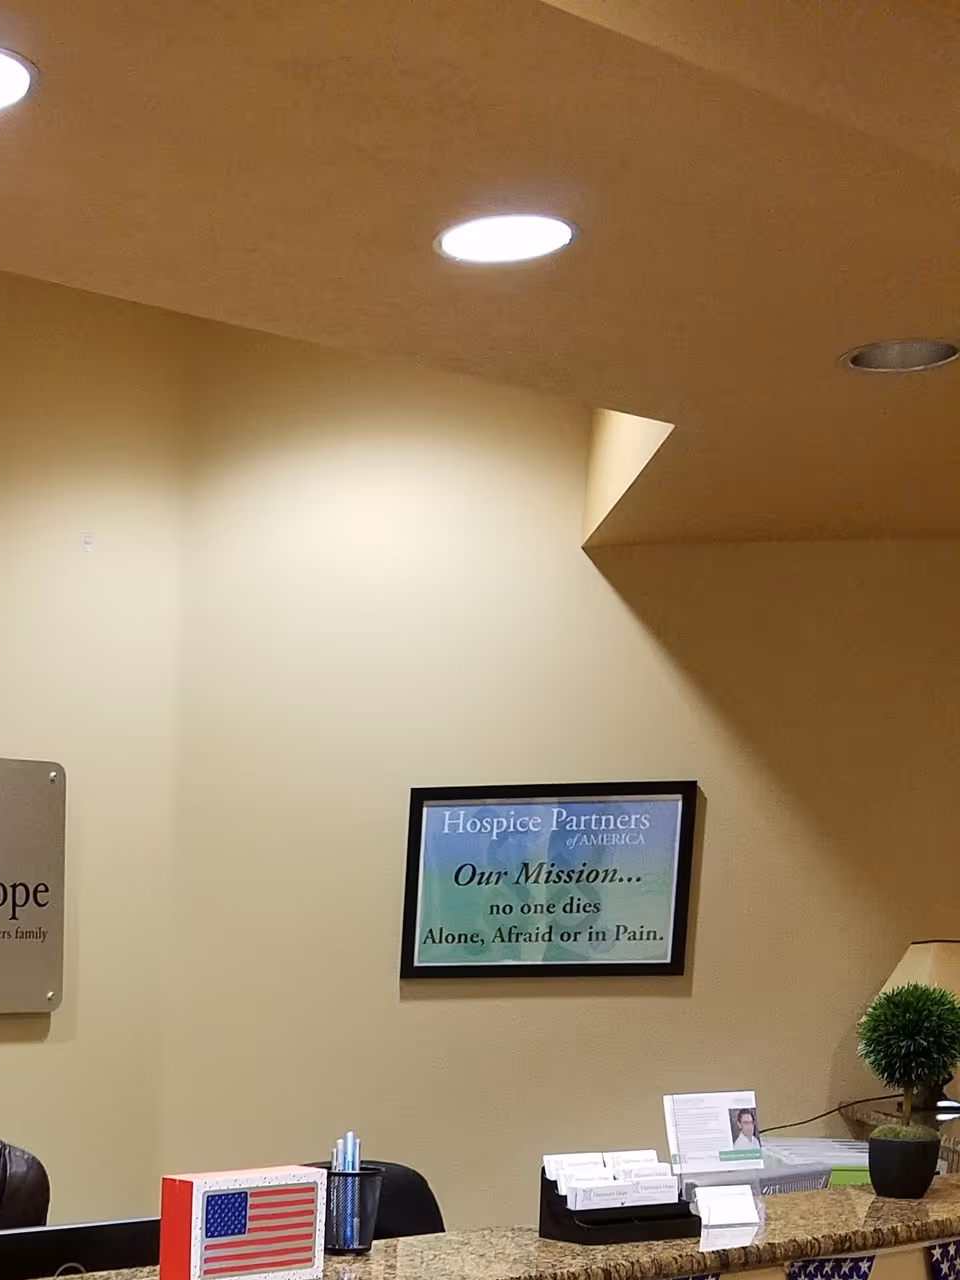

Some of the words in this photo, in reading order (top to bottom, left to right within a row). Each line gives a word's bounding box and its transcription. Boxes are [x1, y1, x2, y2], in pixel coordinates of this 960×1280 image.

[442, 811, 541, 840] Hospice
[551, 807, 650, 831] Partners
[566, 833, 581, 850] of
[580, 833, 645, 846] AMERICA
[454, 863, 508, 886] Our
[512, 862, 642, 884] Mission...
[489, 903, 514, 915] no
[520, 903, 556, 914] one
[562, 896, 601, 914] dies
[14, 926, 48, 943] family
[422, 926, 485, 946] Alone,
[490, 925, 553, 944] Afraid
[560, 930, 582, 942] or
[587, 925, 607, 942] in
[615, 924, 664, 941] Pain.
